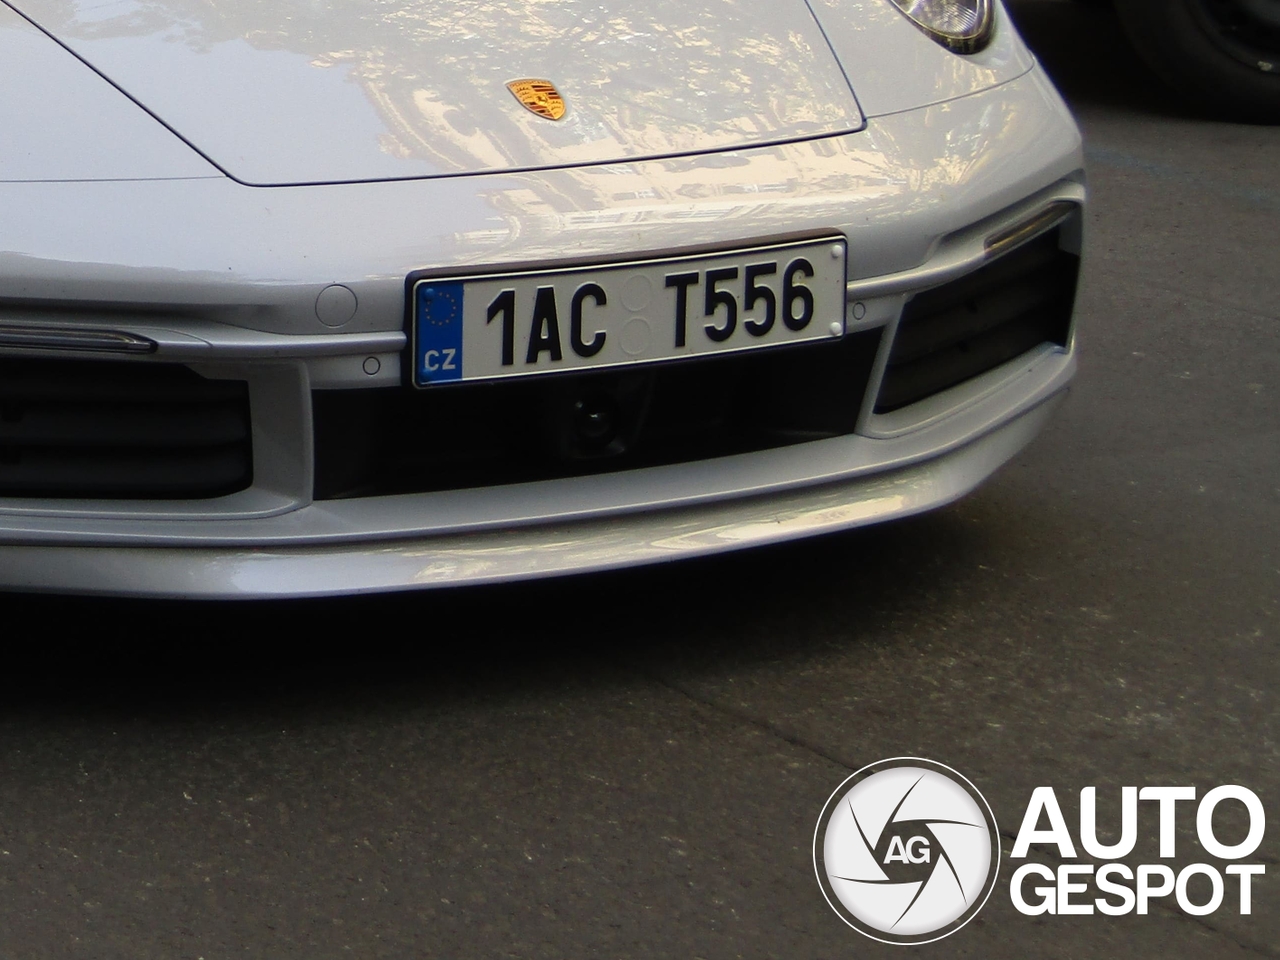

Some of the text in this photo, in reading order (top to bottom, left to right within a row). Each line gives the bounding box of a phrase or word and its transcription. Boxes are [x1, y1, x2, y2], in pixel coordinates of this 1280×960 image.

[424, 257, 815, 371] CZ 1AC T556
